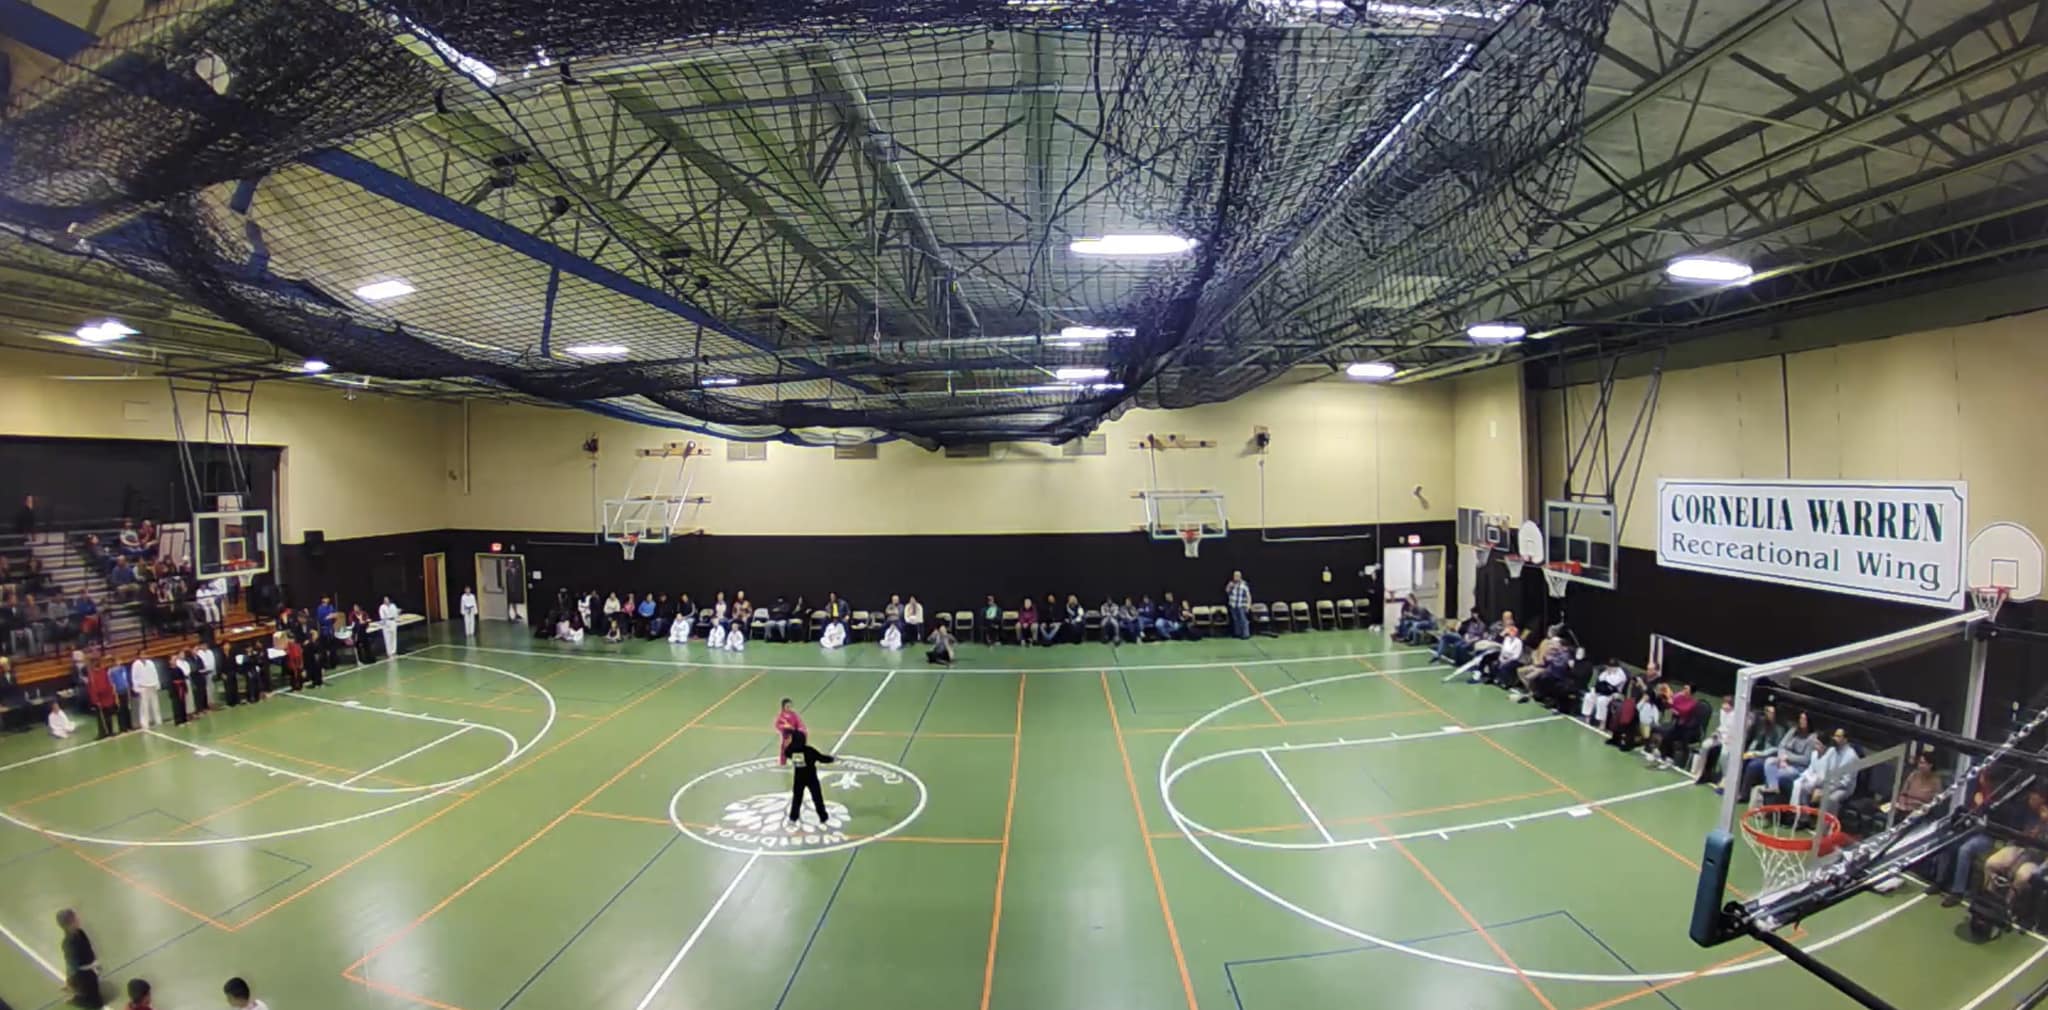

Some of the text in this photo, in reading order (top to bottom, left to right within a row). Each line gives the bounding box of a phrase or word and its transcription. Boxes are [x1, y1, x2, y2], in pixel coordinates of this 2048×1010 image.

[1671, 493, 1945, 543] CORNELIA WARREN
[1671, 531, 1941, 592] Recreational Wing
